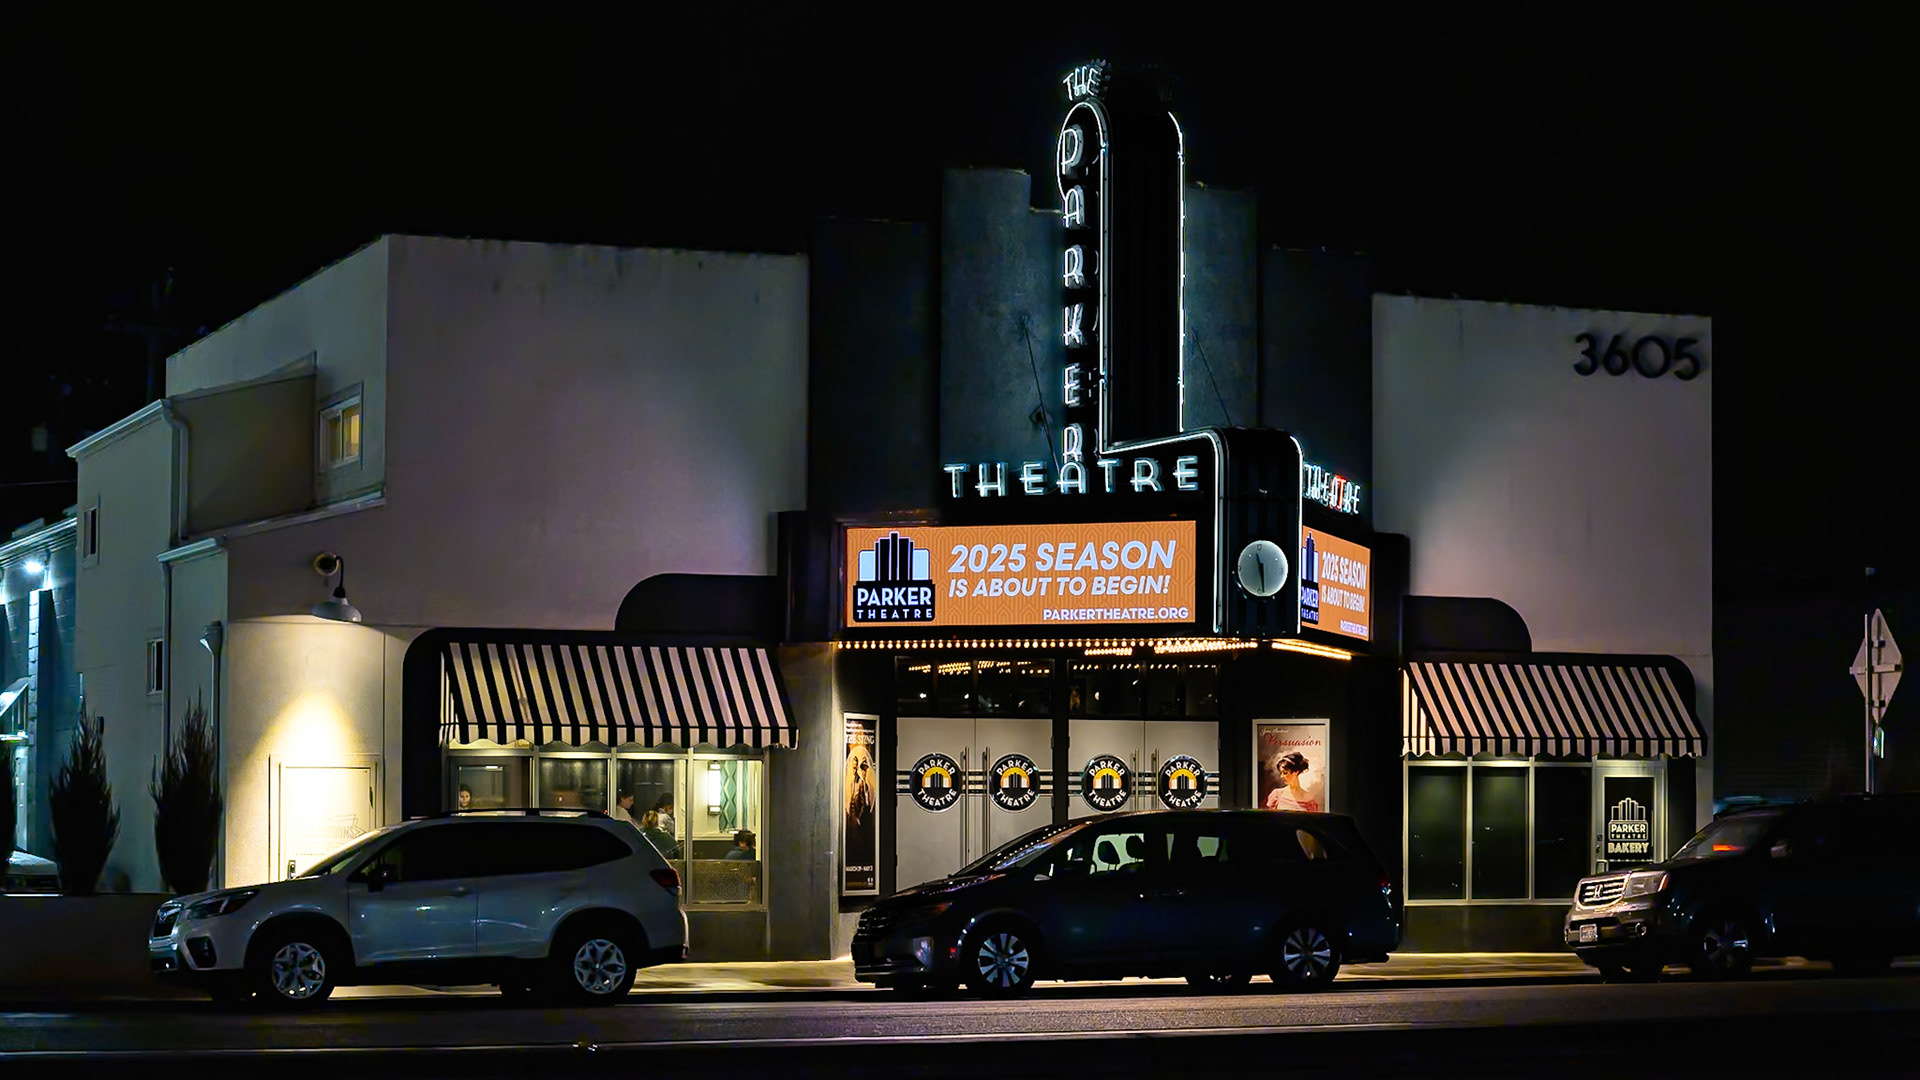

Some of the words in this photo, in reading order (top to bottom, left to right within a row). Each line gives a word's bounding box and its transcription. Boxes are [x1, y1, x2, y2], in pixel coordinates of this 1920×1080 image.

[1062, 65, 1101, 101] THE
[1061, 124, 1086, 462] PARKER
[1573, 332, 1700, 381] 3605
[944, 455, 1199, 498] THEATRE
[1303, 463, 1361, 514] THEATRE
[948, 543, 1027, 573] 2025
[1035, 539, 1177, 572] SEASON
[1321, 551, 1339, 582] 2025
[1339, 556, 1367, 590] SEASON
[948, 578, 968, 598] IS
[972, 576, 1052, 597] ABOUT
[1056, 576, 1087, 596] TO
[1091, 575, 1171, 595] BEGIN!
[857, 587, 932, 606] PARKER
[856, 609, 932, 619] THEATRE
[1043, 607, 1190, 621] PARKERTHEATRE.ORG
[1263, 732, 1322, 747] Persuasion
[917, 759, 956, 775] PARKER
[996, 759, 1034, 775] PARKER
[1088, 760, 1126, 777] PARKER
[1164, 761, 1201, 778] PARKER
[917, 788, 957, 806] THEATRE
[996, 788, 1035, 807] THEATRE
[1088, 789, 1127, 807] THEATRE
[1164, 790, 1202, 808] THEATRE
[1611, 824, 1646, 833] PARKER
[1608, 842, 1649, 854] BAKERY
